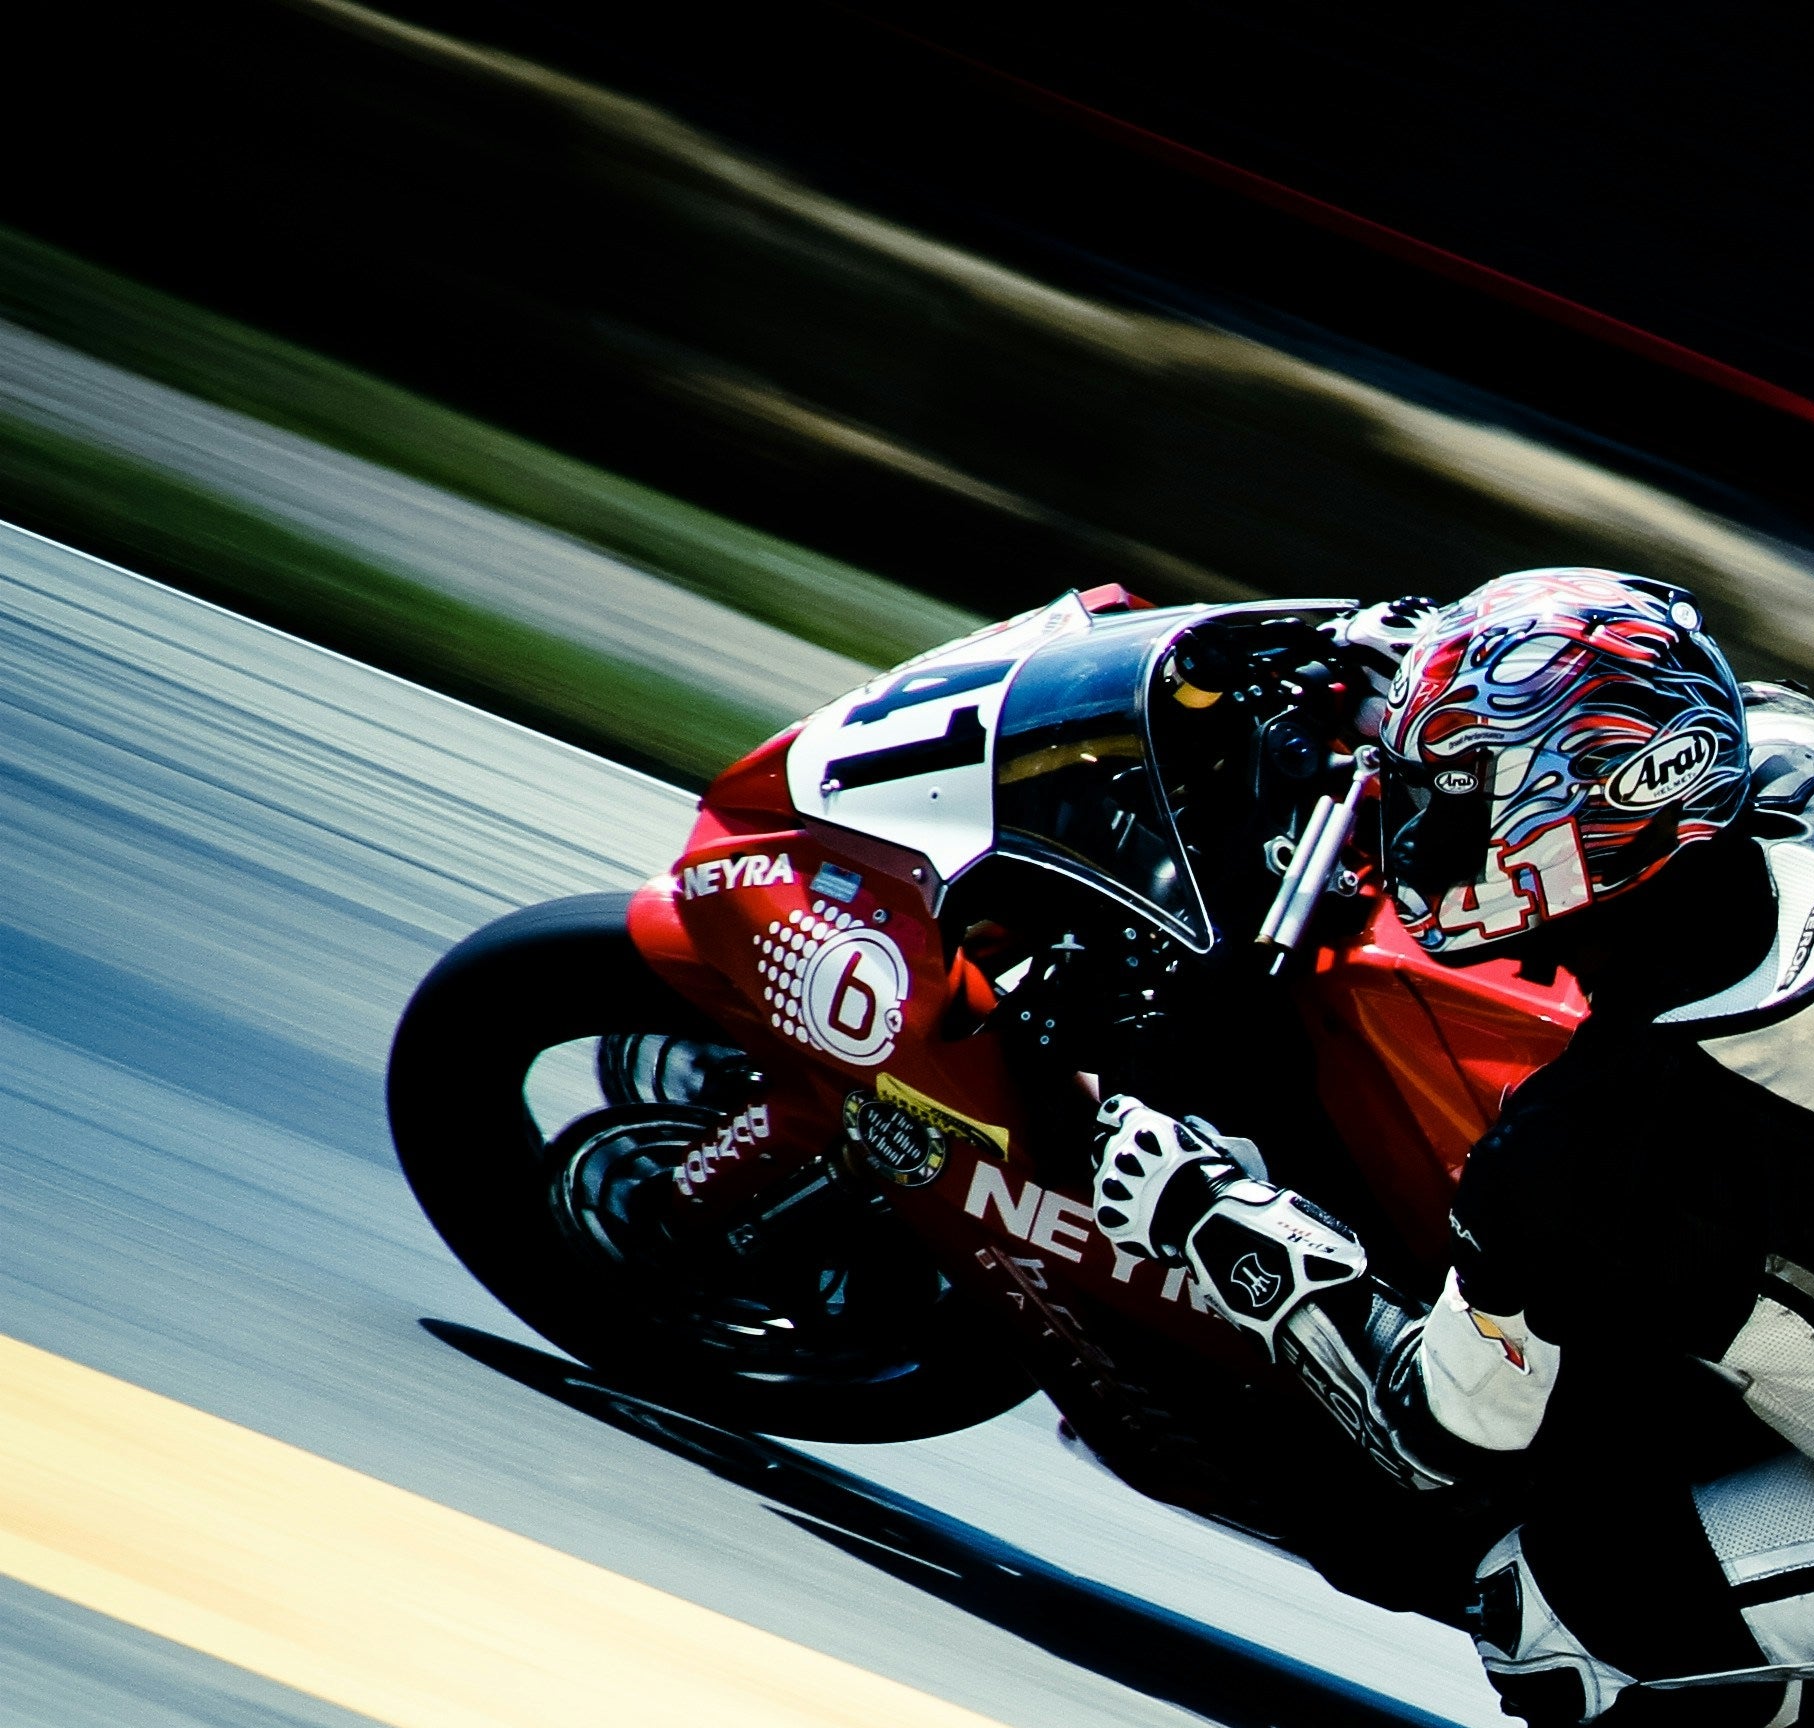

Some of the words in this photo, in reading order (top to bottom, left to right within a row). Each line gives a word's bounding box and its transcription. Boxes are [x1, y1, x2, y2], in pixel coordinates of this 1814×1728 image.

[822, 658, 1020, 793] 41
[1440, 773, 1472, 788] Arai
[1621, 732, 1706, 802] Arai
[683, 852, 794, 901] NEYRA
[1438, 816, 1592, 939] 41
[890, 1111, 914, 1131] The
[868, 1126, 906, 1166] School
